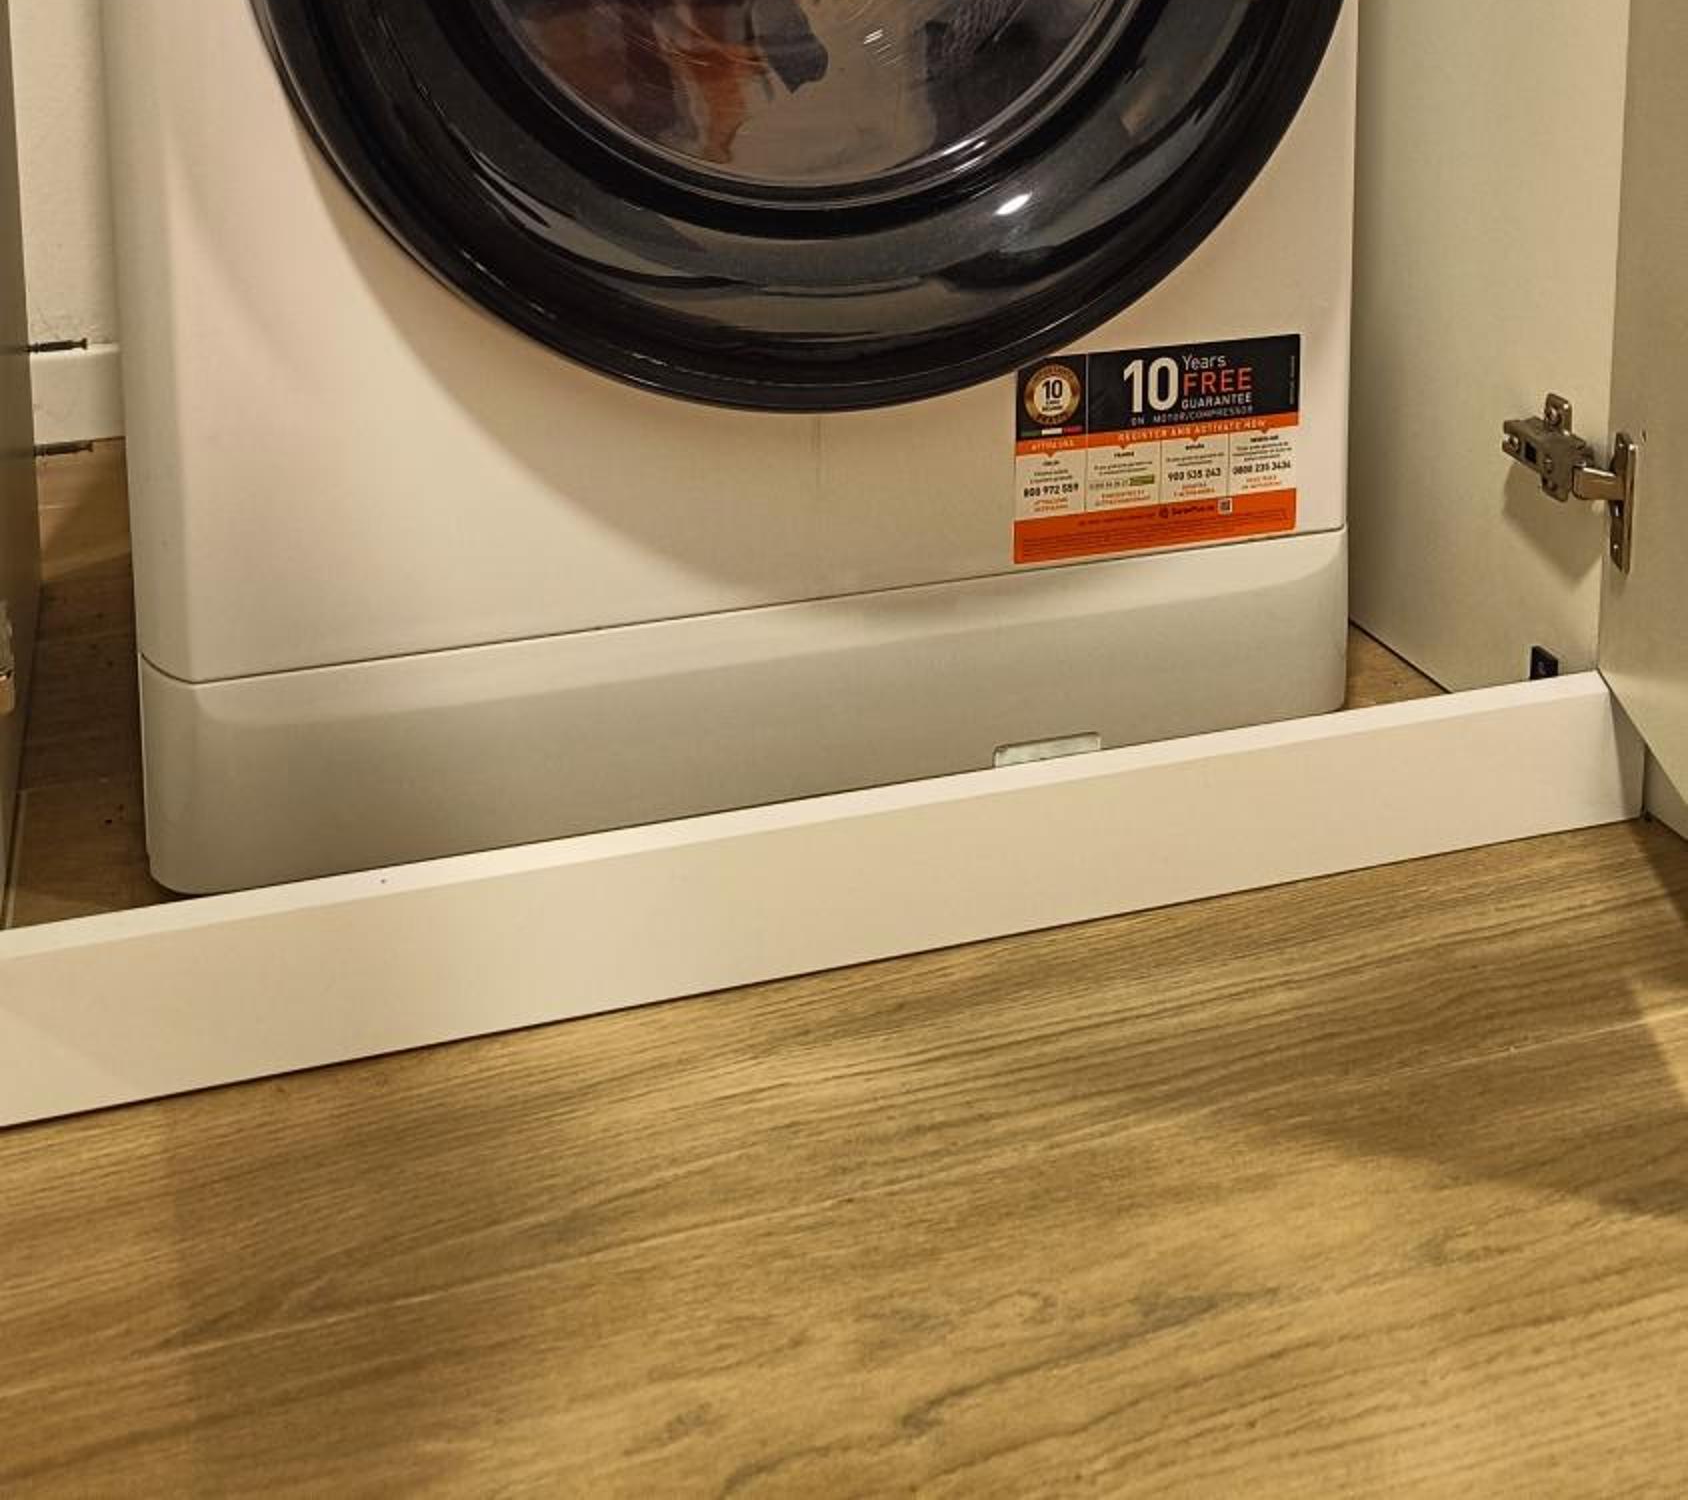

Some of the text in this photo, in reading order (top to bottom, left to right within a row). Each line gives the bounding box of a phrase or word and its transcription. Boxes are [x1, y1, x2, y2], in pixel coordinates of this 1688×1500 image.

[1041, 379, 1064, 399] 10
[1123, 357, 1179, 414] 10
[1181, 353, 1227, 371] Years
[1182, 367, 1253, 397] FREE
[1181, 392, 1253, 409] GUARANTEE
[1152, 405, 1254, 424] MOTOR/COMPRESSOR
